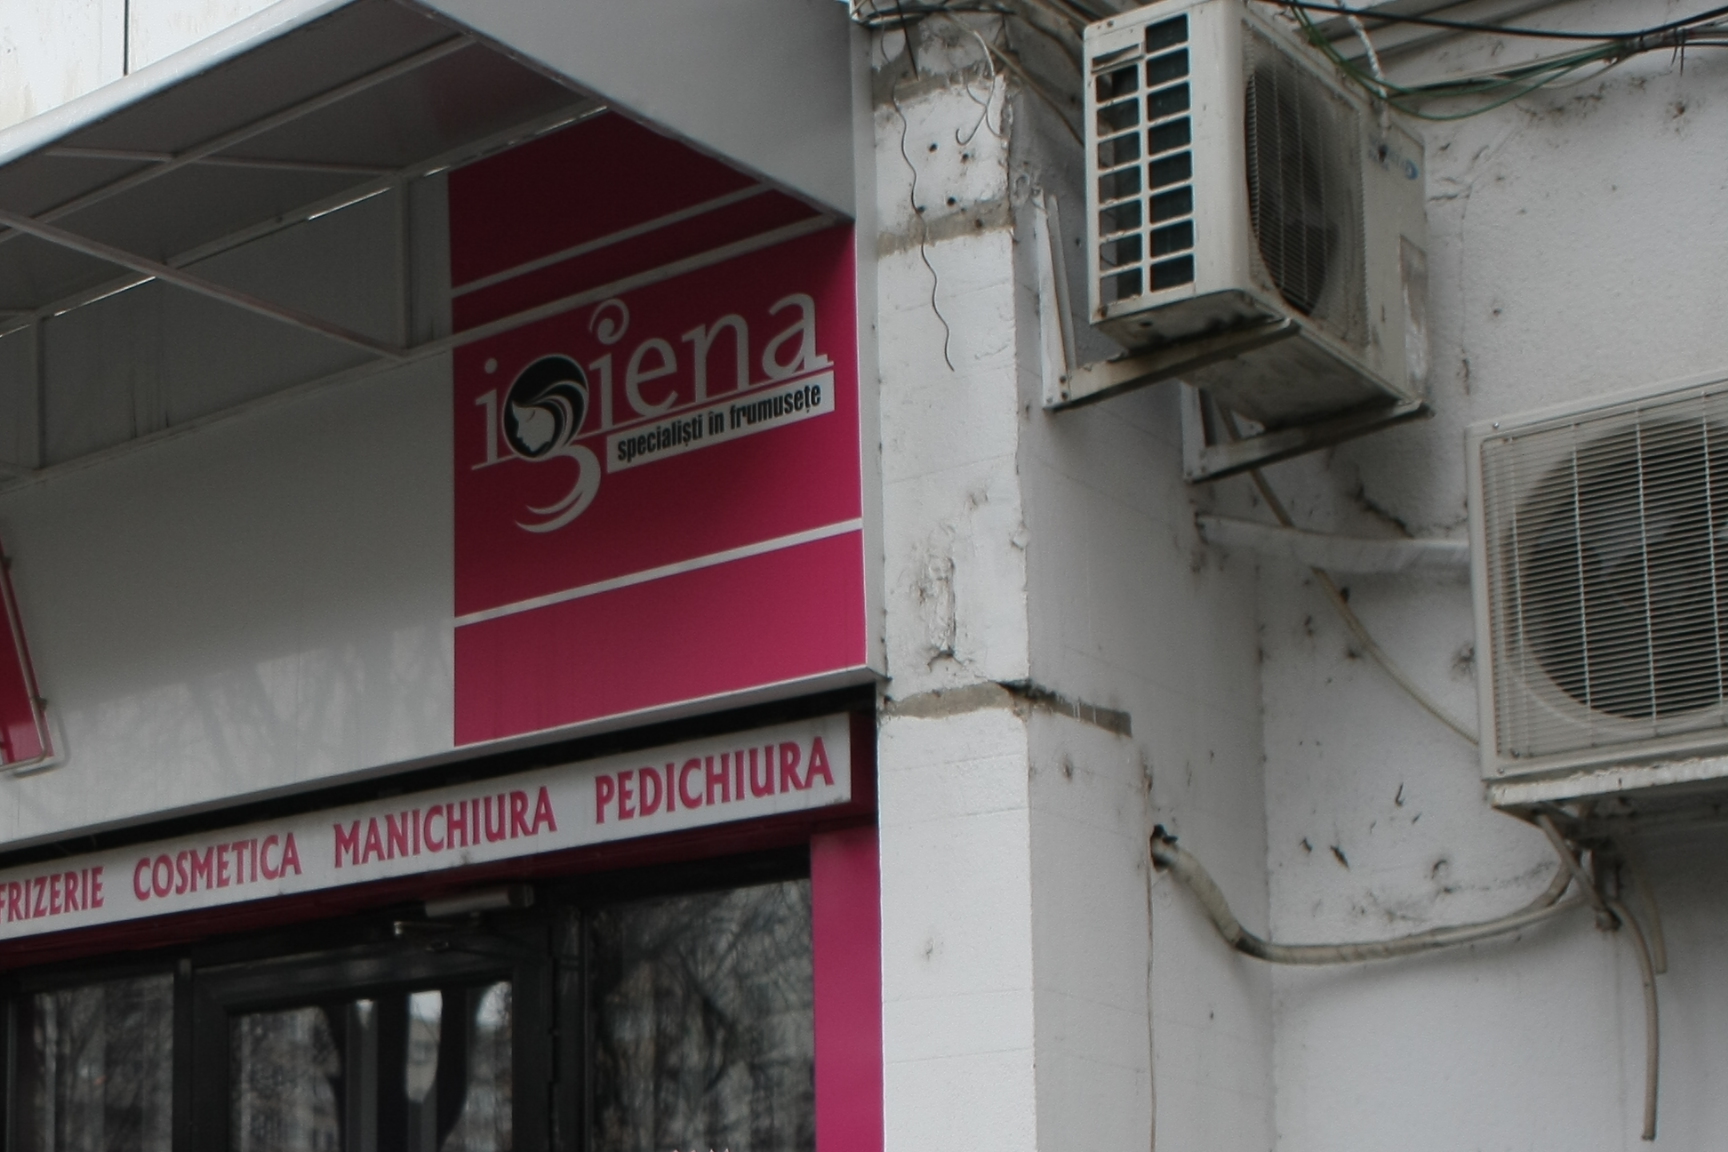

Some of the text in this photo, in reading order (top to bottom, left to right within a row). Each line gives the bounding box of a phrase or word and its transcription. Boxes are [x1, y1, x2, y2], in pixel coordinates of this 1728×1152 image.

[133, 832, 302, 901] COSMETICA
[334, 786, 557, 869] MANICHIURA
[595, 737, 834, 825] PEDICHIURA
